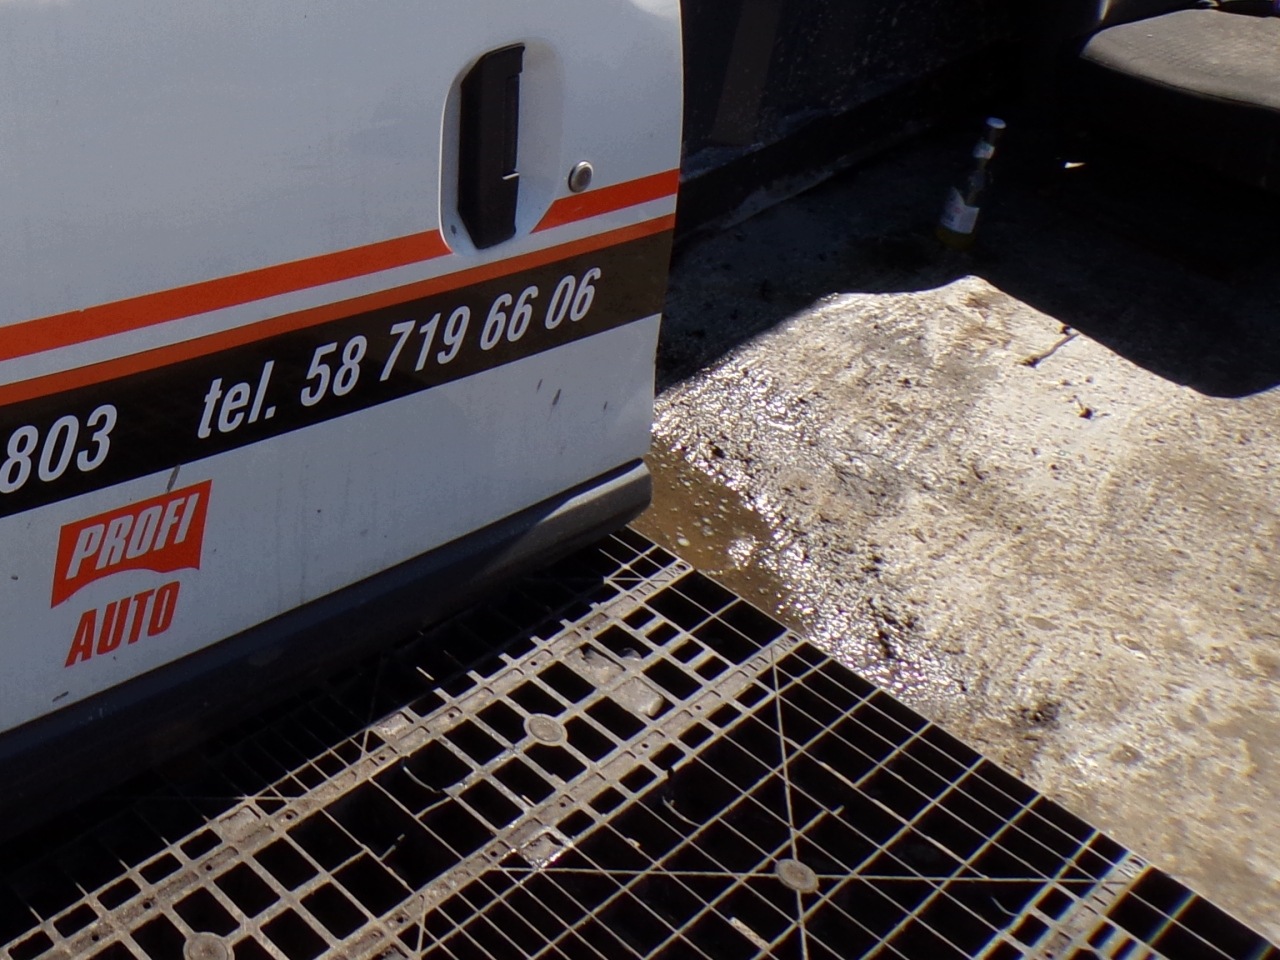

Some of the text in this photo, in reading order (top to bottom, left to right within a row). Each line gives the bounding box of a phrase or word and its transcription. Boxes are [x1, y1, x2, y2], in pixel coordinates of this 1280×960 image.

[197, 360, 276, 439] tel.
[300, 334, 368, 407] 58
[379, 305, 471, 382] 719
[479, 285, 539, 351] 66
[544, 266, 602, 330] 06
[65, 492, 201, 581] PROFI
[64, 581, 181, 668] AUTO
